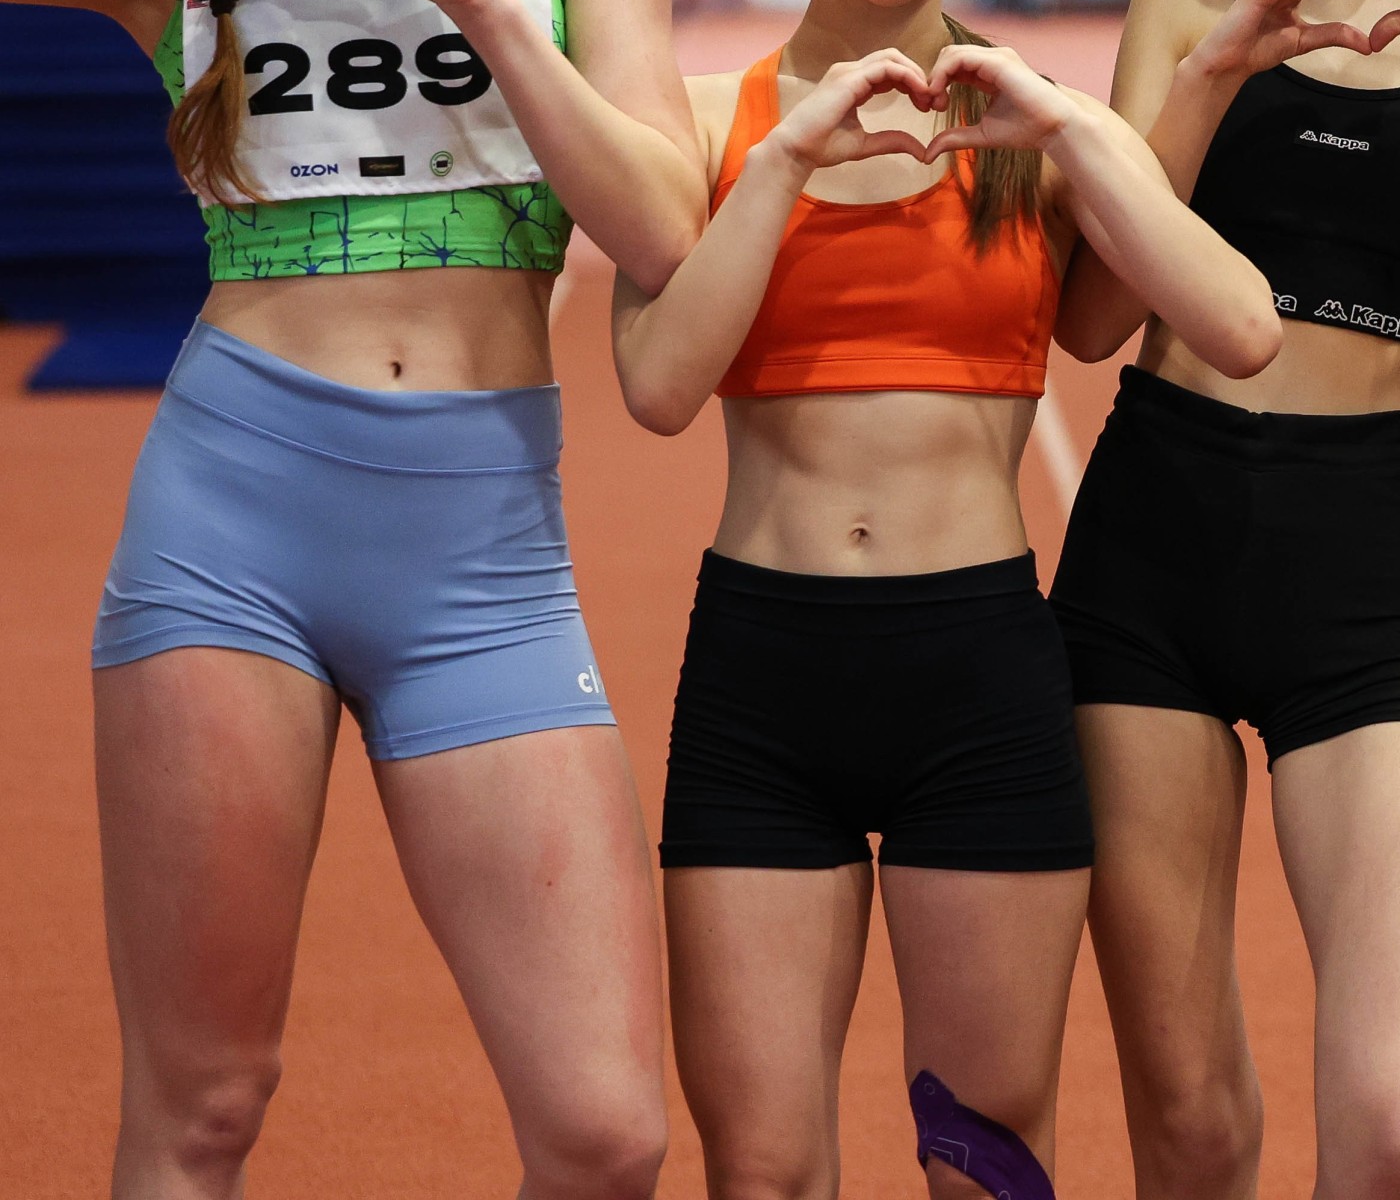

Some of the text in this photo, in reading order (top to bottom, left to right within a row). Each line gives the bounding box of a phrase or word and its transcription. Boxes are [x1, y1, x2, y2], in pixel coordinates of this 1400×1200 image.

[243, 32, 493, 116] 289
[1319, 132, 1369, 151] Kappa
[290, 163, 339, 177] OZON
[577, 664, 604, 693] cl
